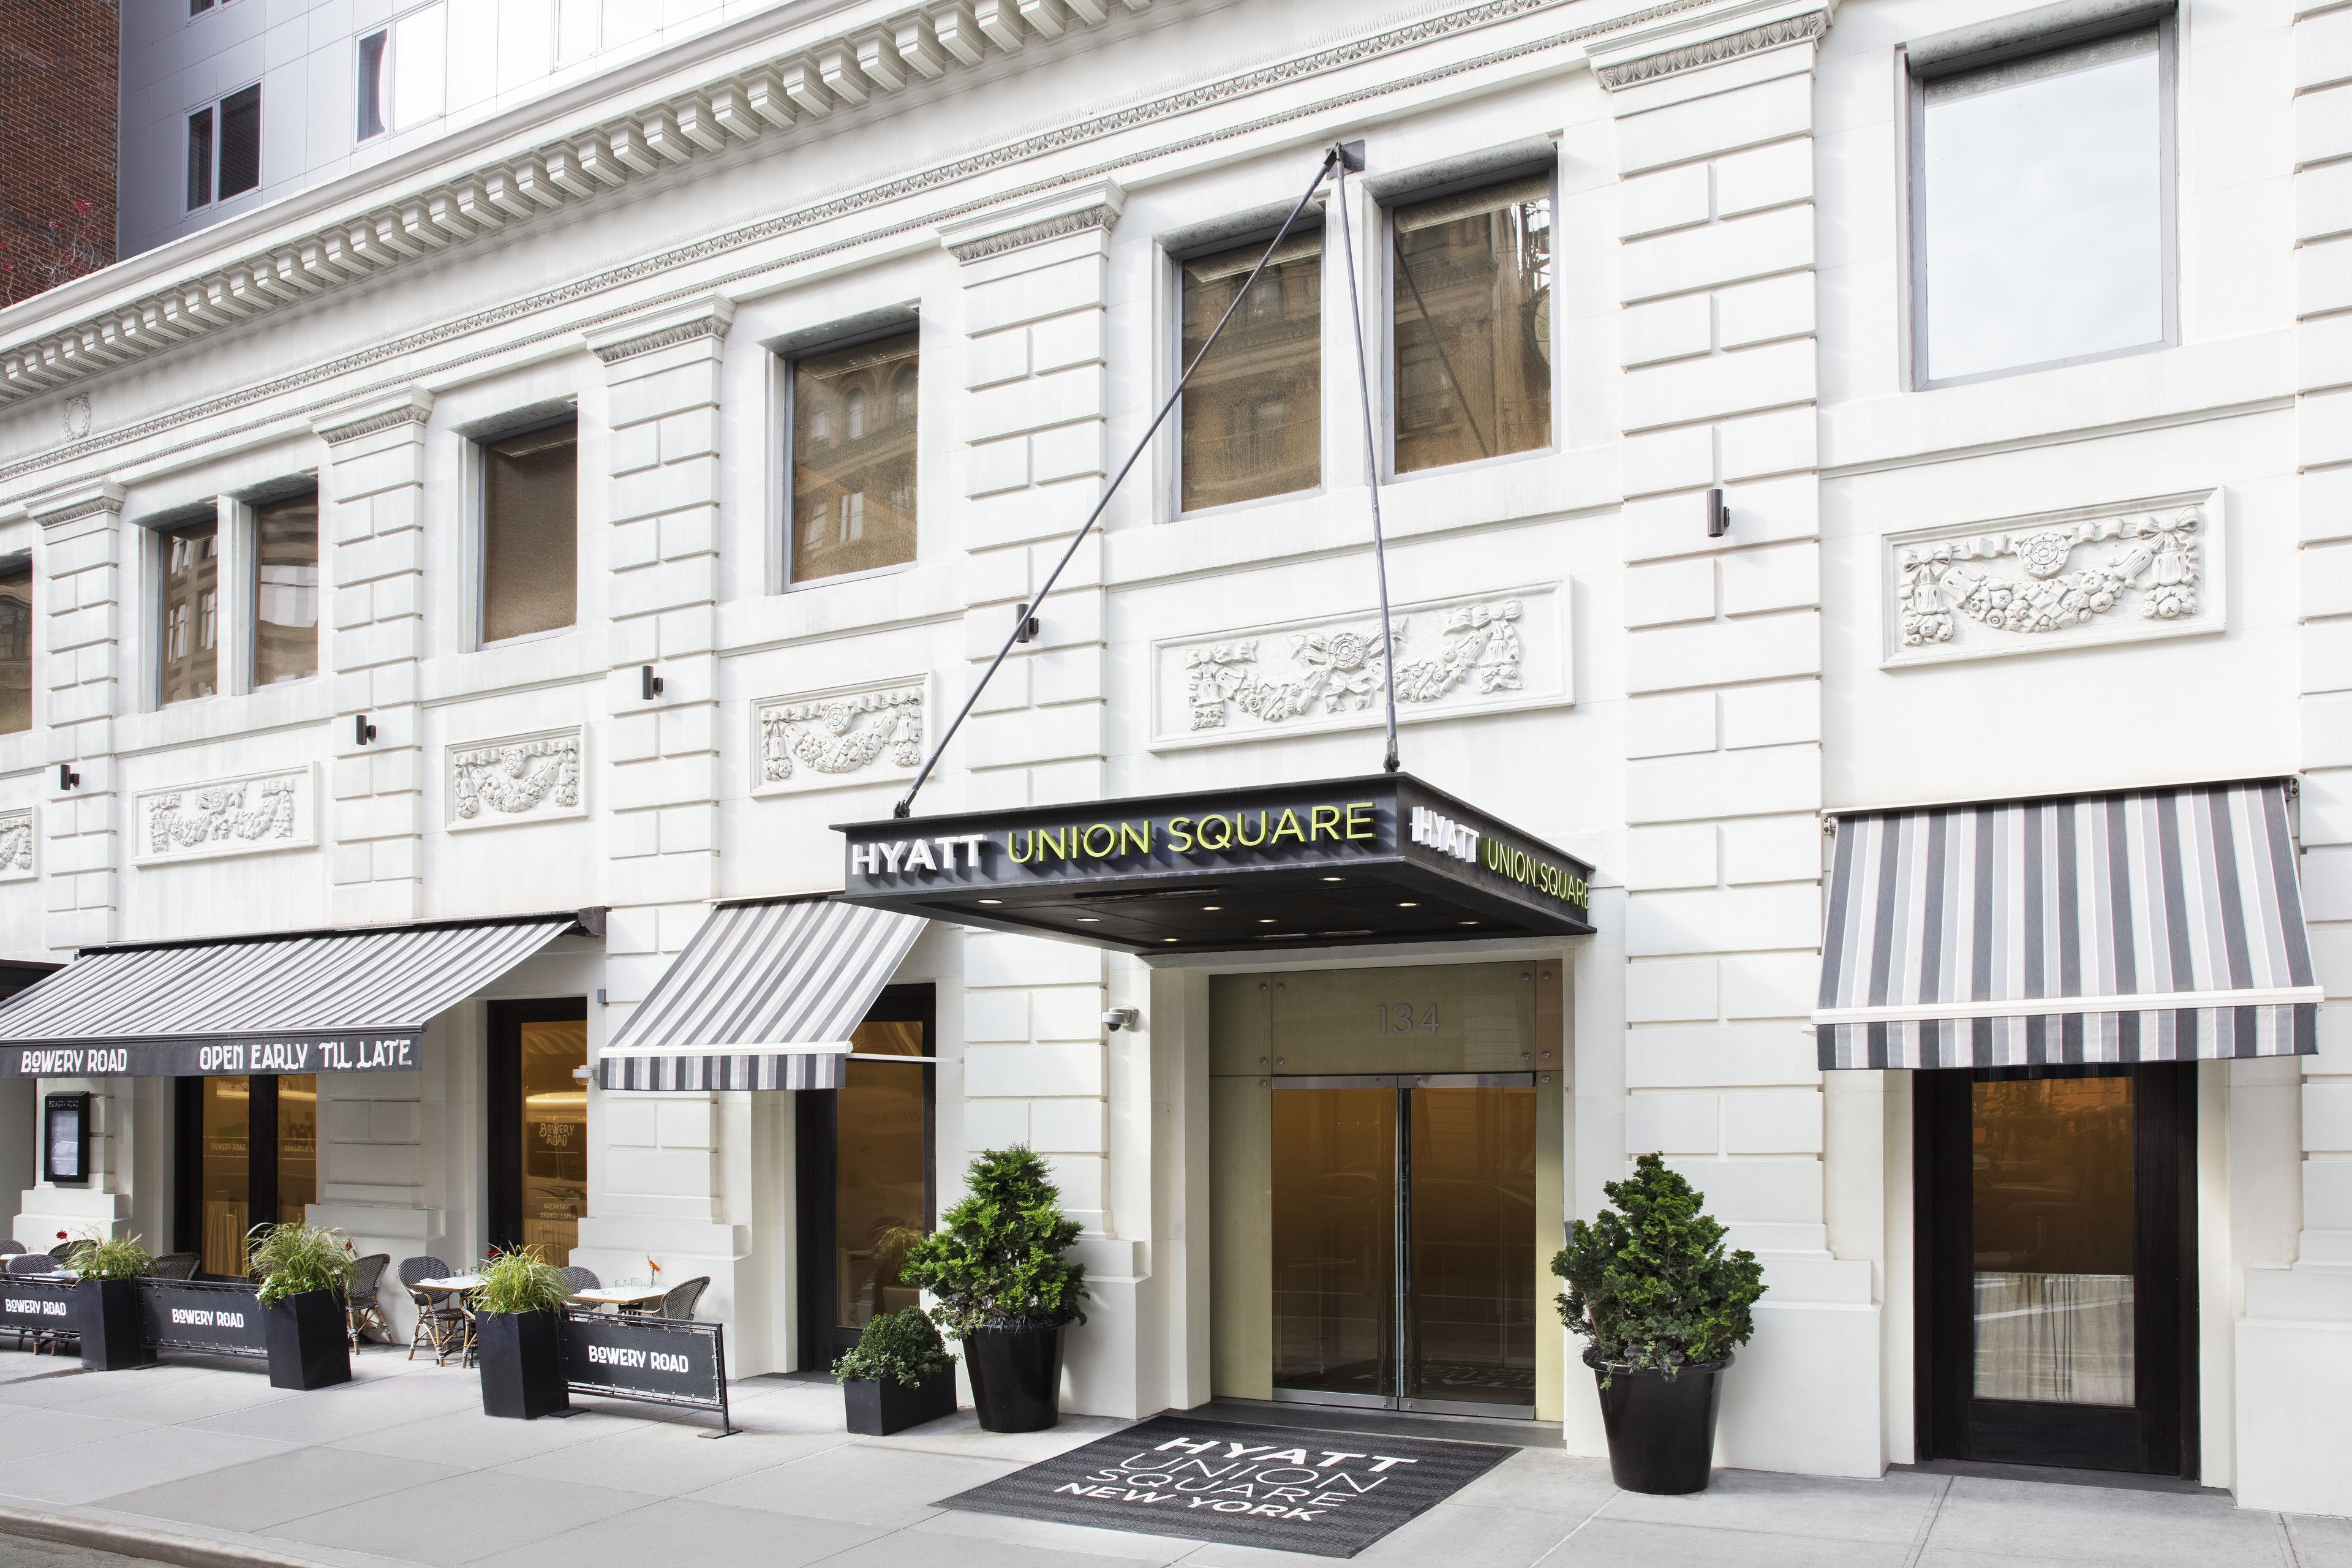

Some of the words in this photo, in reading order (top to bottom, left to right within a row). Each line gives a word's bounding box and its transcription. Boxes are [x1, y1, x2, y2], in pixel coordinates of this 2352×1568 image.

[852, 834, 988, 875] HYATT
[1008, 820, 1152, 864] UNION
[1167, 802, 1376, 853] SQUARE
[1411, 806, 1480, 863] HYATT
[1480, 837, 1536, 887] UNION
[1534, 862, 1591, 911] SQUARE
[1376, 1003, 1439, 1035] 134
[87, 1049, 127, 1072] ROAD
[200, 1045, 244, 1070] OPEN
[251, 1043, 308, 1071] EARLY
[318, 1042, 352, 1069] TIL
[356, 1039, 412, 1069] LATE
[233, 1143, 246, 1152] ROAD
[546, 1134, 567, 1147] ROAD
[43, 1301, 67, 1316] ROAD
[217, 1312, 244, 1329] ROAD
[650, 1352, 688, 1373] ROAD
[1153, 1437, 1418, 1472] HYATT
[1086, 1469, 1357, 1507] SQUARE
[1120, 1453, 1388, 1493] UNION
[1053, 1482, 1177, 1503] NEW
[1187, 1496, 1327, 1521] YORK
